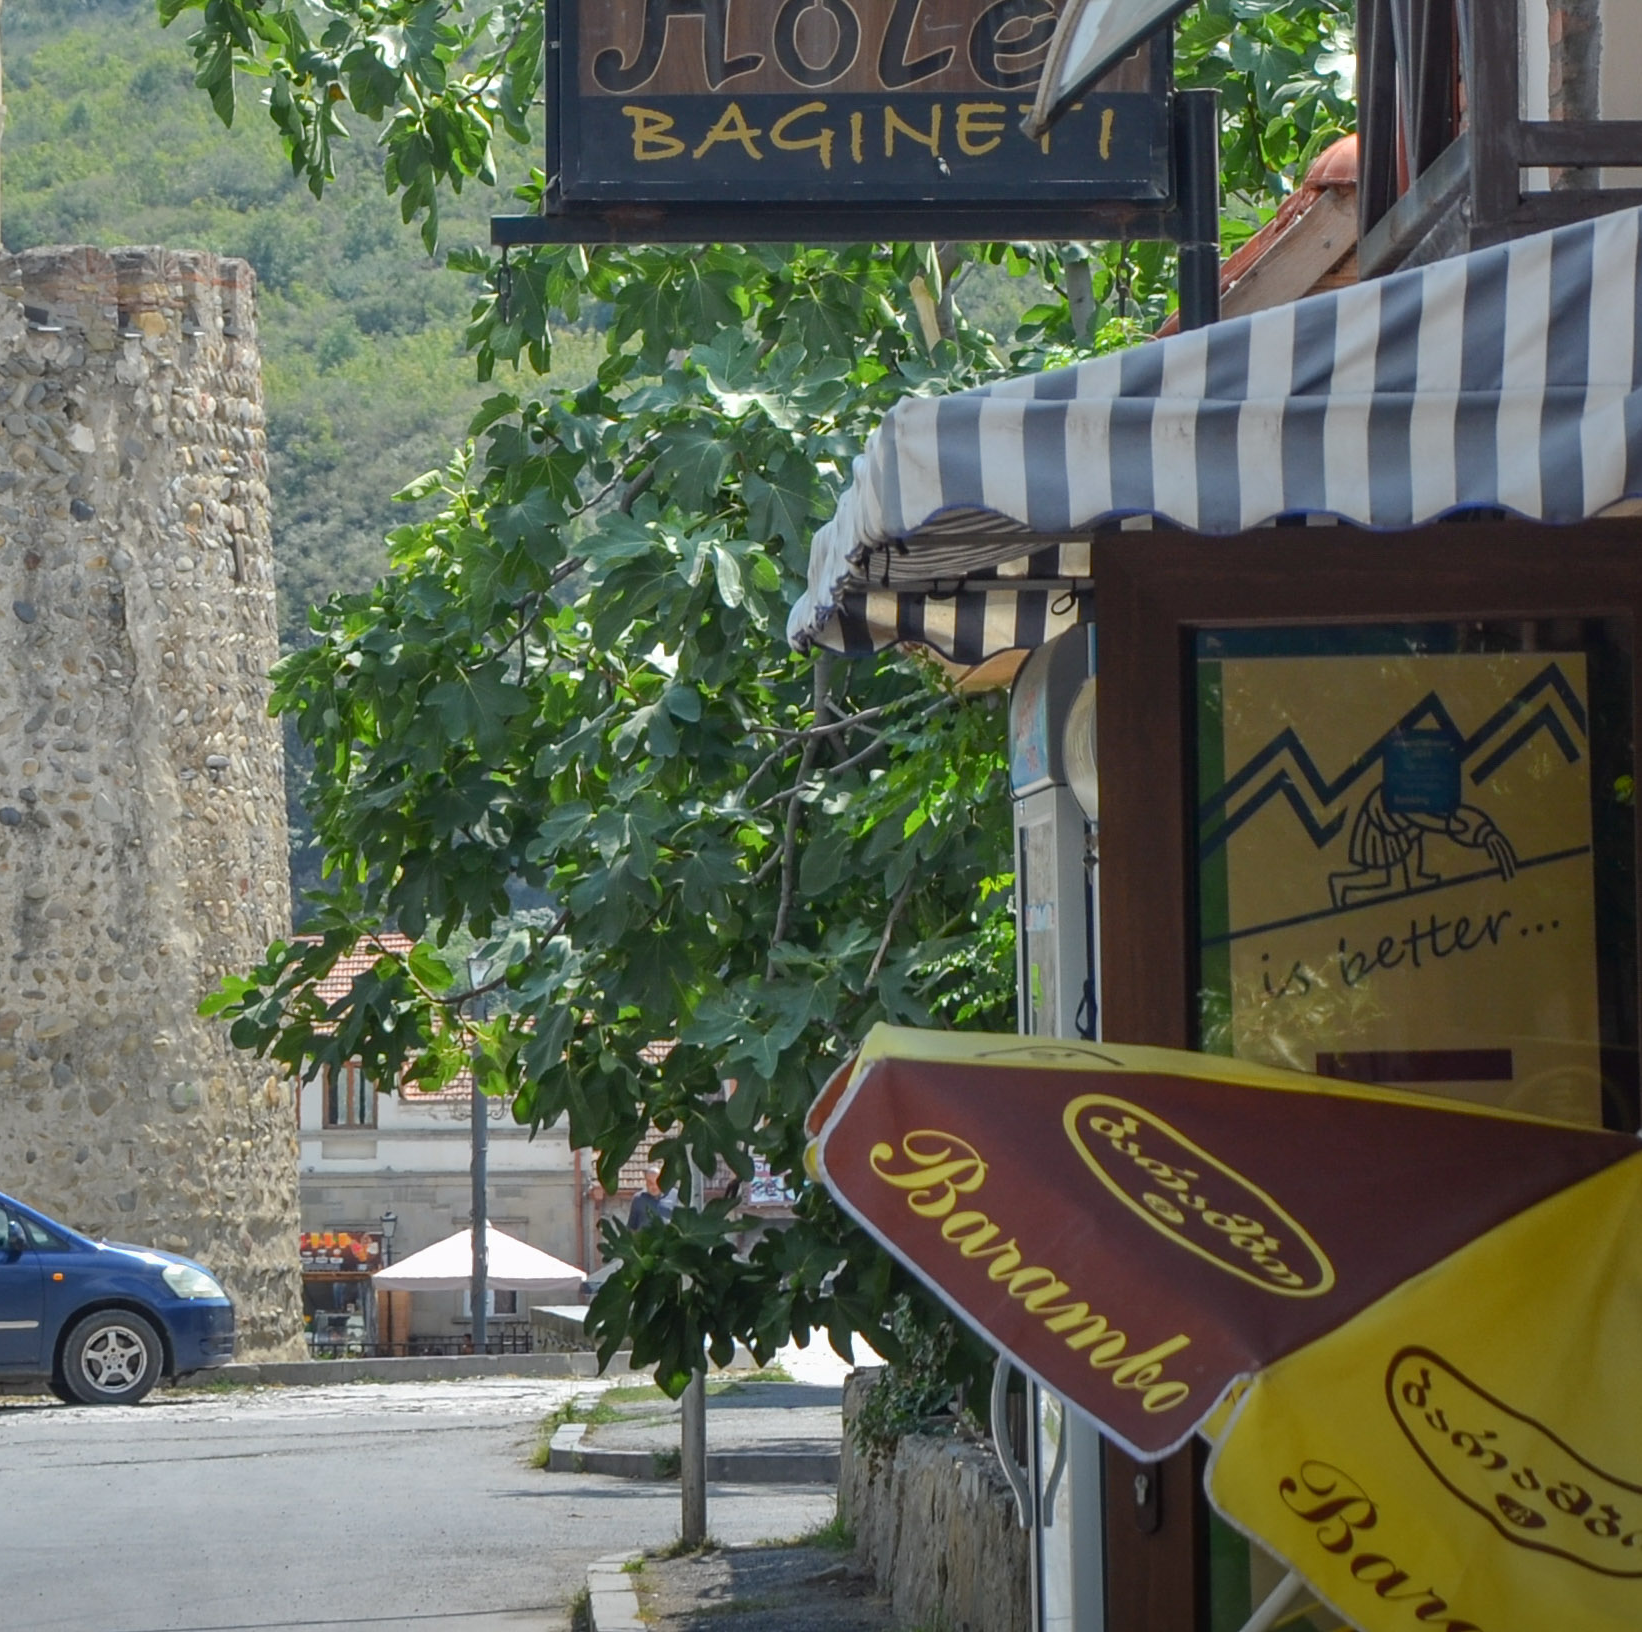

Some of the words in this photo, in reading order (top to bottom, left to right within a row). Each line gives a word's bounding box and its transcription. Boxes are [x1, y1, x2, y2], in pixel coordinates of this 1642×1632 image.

[1261, 952, 1311, 999] is
[869, 1129, 1192, 1413] Barambo
[1089, 1115, 1304, 1287] ბარამბო
